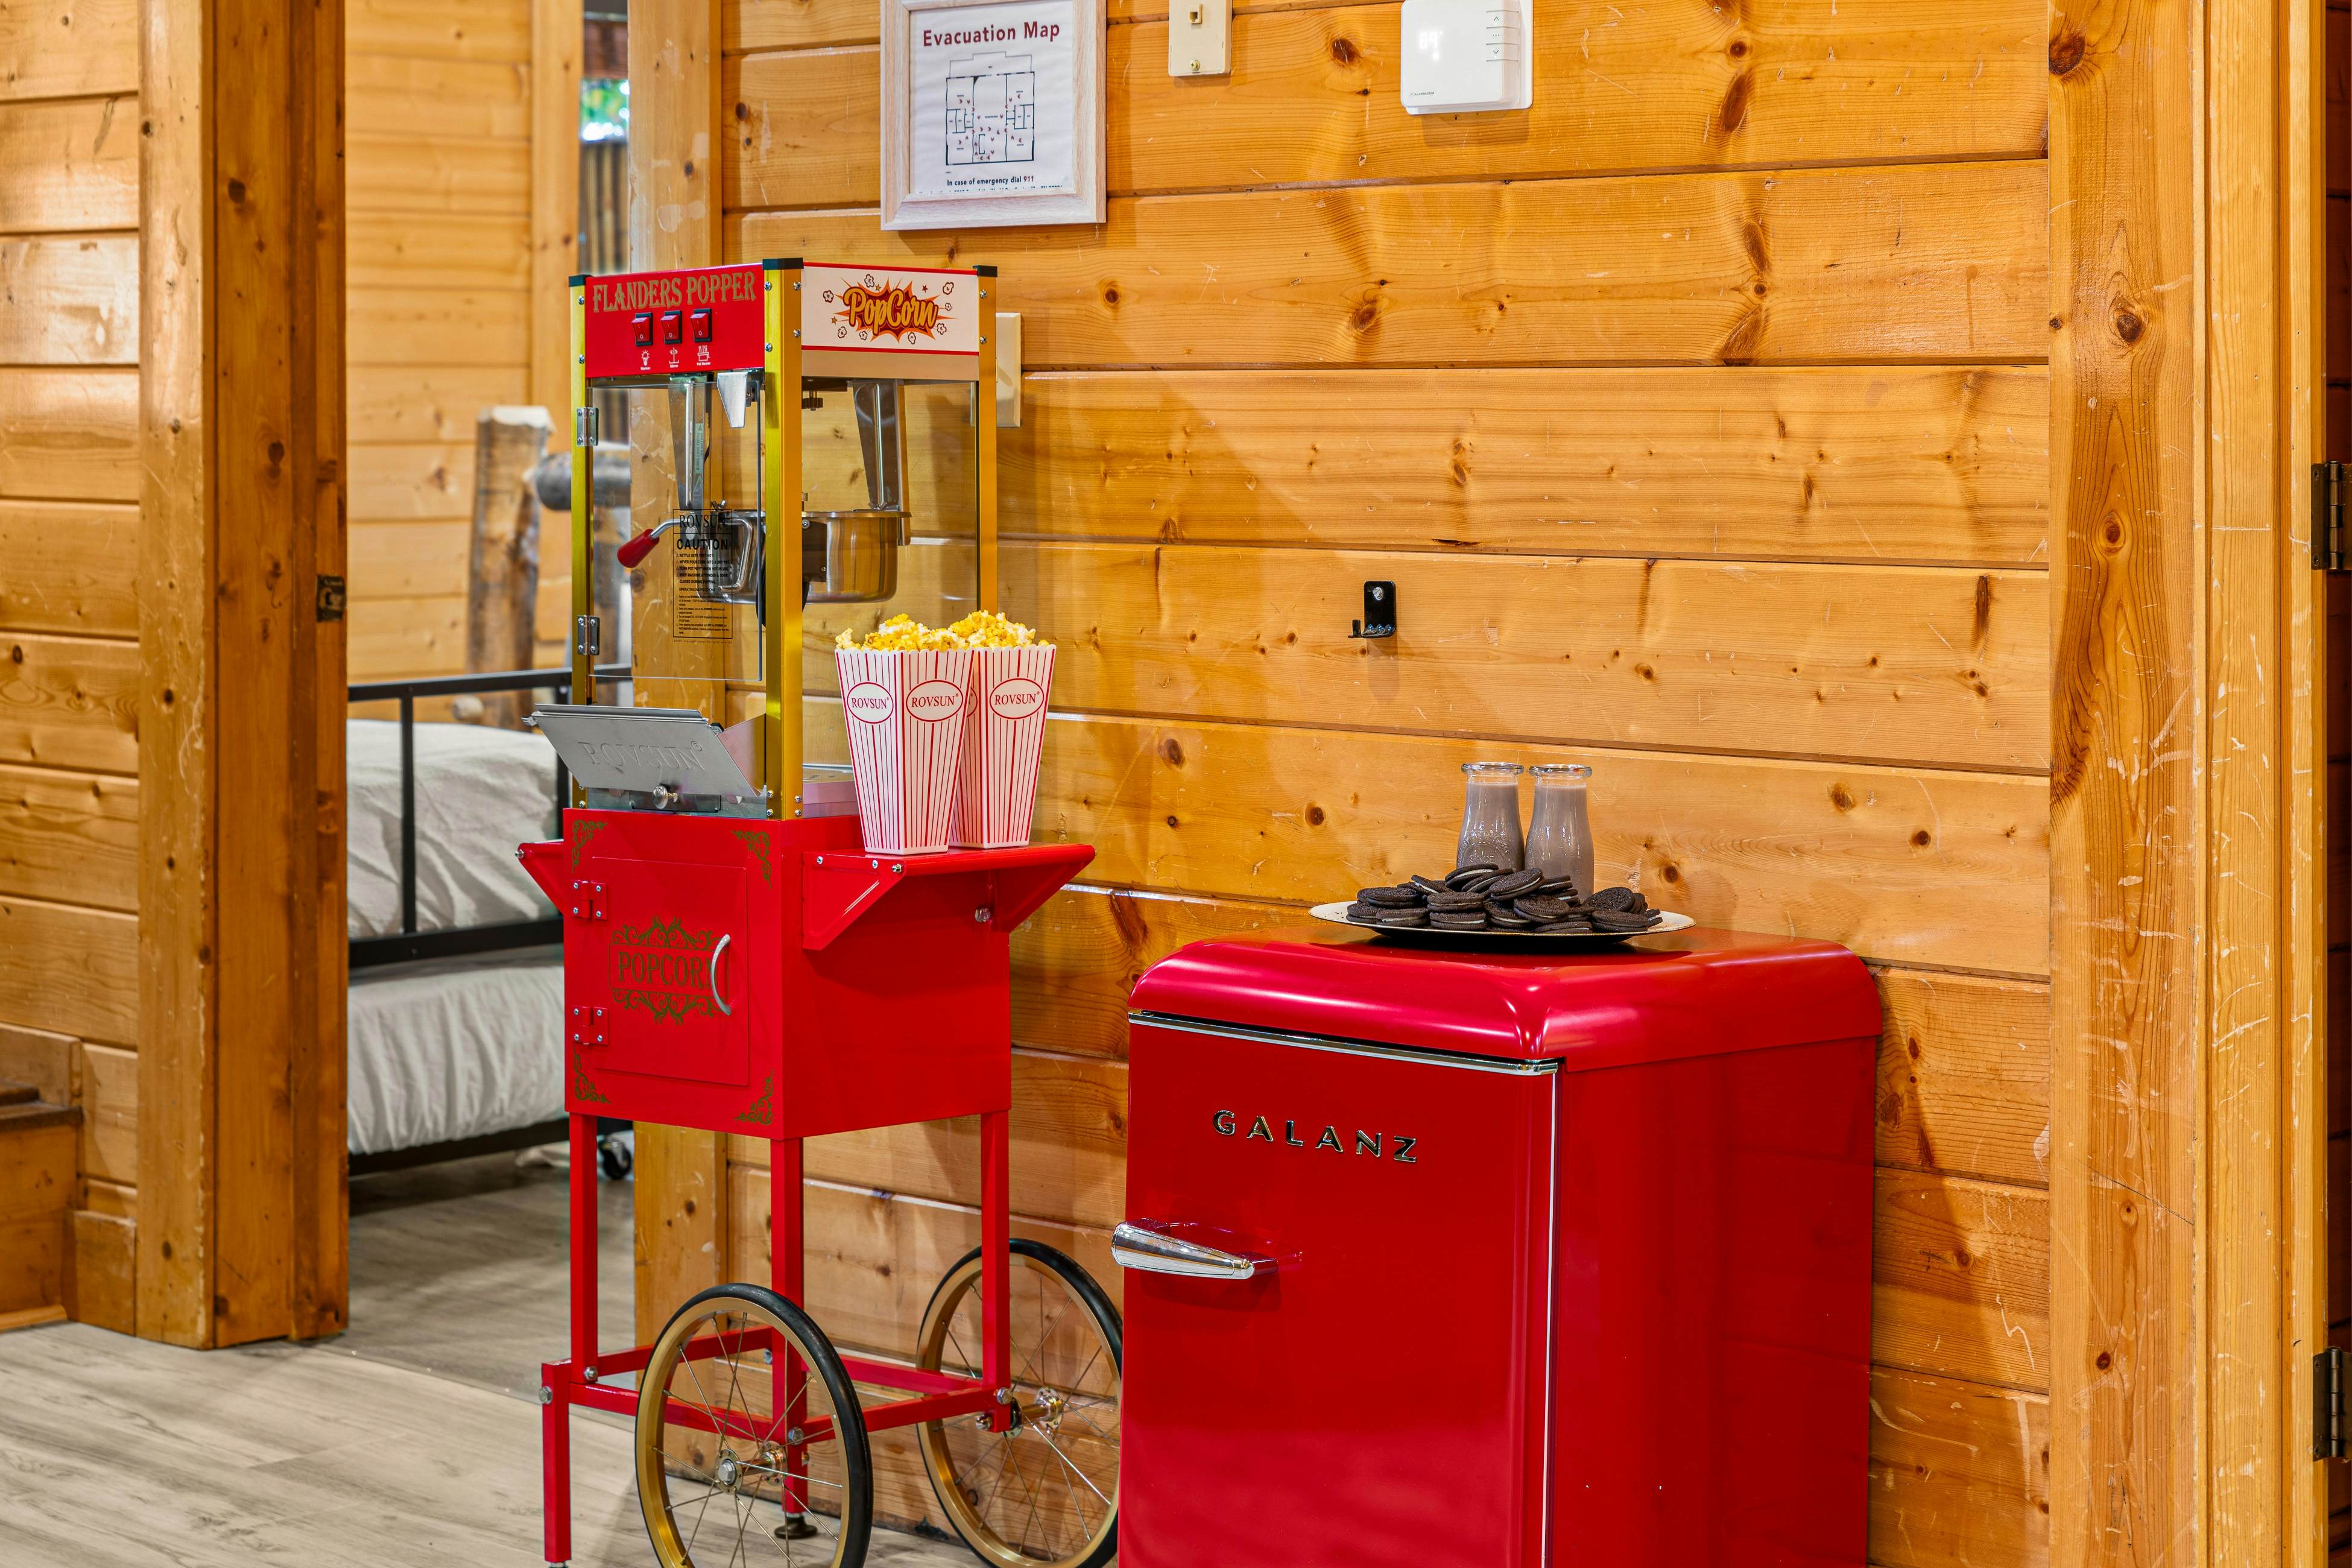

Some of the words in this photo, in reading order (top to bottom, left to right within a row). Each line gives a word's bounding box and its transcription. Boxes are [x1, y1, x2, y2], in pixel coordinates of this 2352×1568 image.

[923, 24, 1016, 46] Evacuation
[1024, 21, 1060, 42] Map
[976, 177, 1008, 186] emergency
[593, 277, 683, 313] FLANDERS
[686, 272, 757, 305] POPPER
[843, 286, 939, 335] PopCorn
[677, 539, 728, 550] CAUTION
[1213, 1110, 1417, 1163] GALANZ
